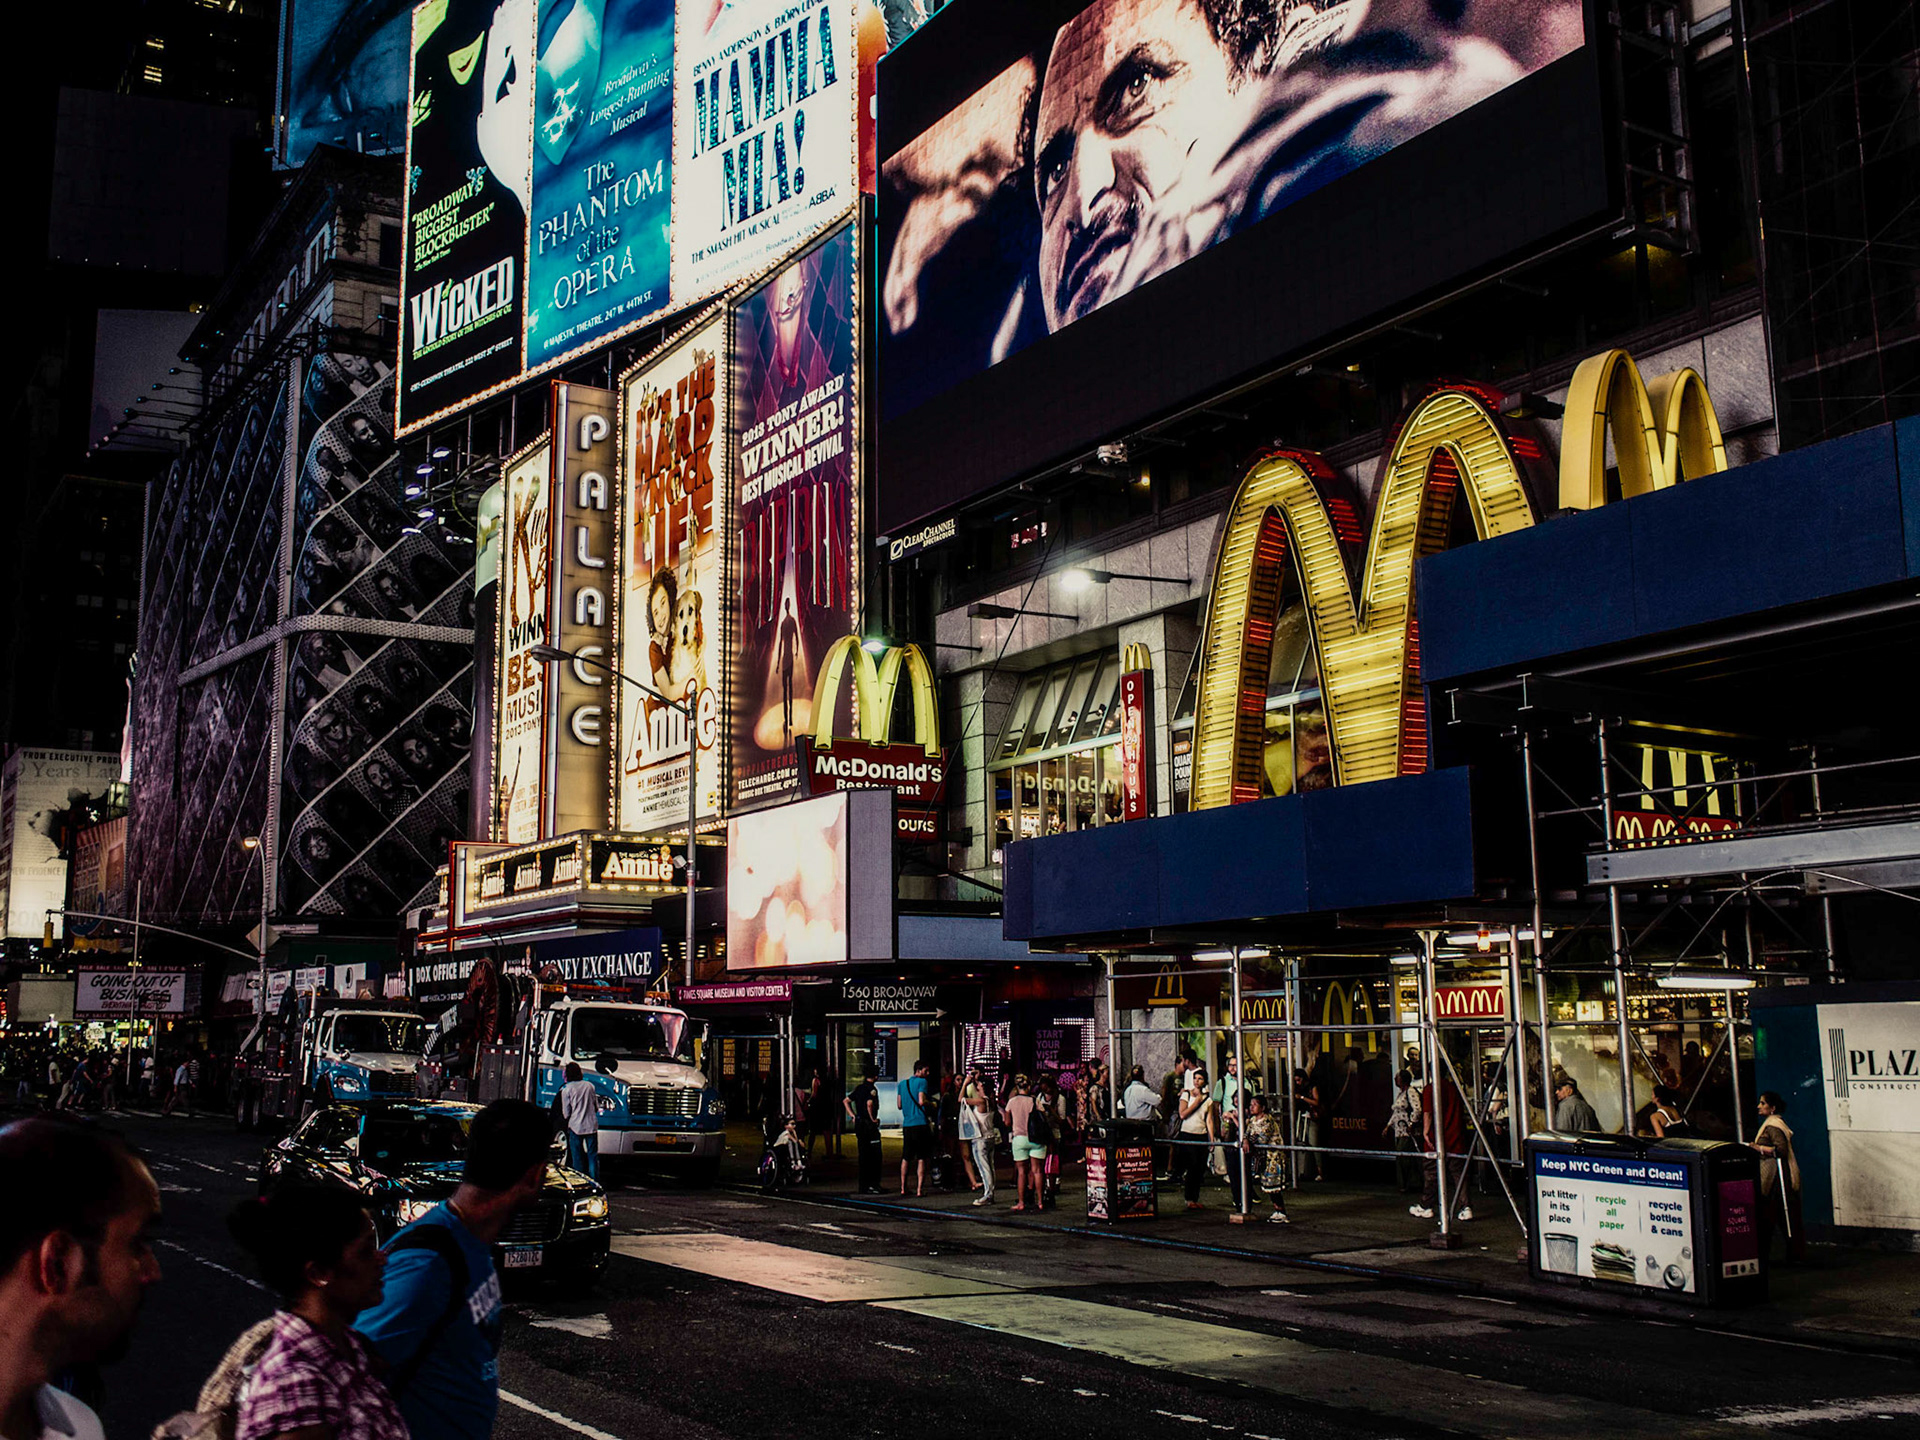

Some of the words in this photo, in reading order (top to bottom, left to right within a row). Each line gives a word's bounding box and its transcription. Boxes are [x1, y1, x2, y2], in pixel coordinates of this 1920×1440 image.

[692, 5, 838, 159] MAMMA
[609, 101, 648, 136] Musical
[583, 160, 615, 190] The
[720, 108, 806, 232] MIA!
[538, 158, 664, 257] PHANTOM
[414, 206, 460, 247] BIGGEST
[576, 231, 595, 263] of
[595, 225, 620, 255] the
[553, 245, 637, 310] OPERA
[677, 356, 716, 416] THE
[742, 421, 765, 447] 2013
[766, 400, 798, 432] TONY
[799, 376, 844, 413] AWARD
[635, 398, 715, 488] HARD
[741, 394, 845, 479] WINNER!
[741, 475, 763, 506] BEST
[763, 453, 804, 493] MUSICAL
[804, 431, 844, 471] REVIVAL
[632, 482, 715, 590] LIFE
[571, 411, 611, 746] PALACE
[23, 751, 46, 760] FROM
[49, 752, 93, 763] EXECUTIVE
[33, 761, 80, 778] Years
[815, 755, 942, 783] McDonald's
[514, 862, 542, 892] Annie
[552, 853, 582, 884] Annie
[600, 851, 674, 882] Annie
[481, 870, 505, 898] Annie
[415, 965, 432, 984] BOX
[432, 962, 458, 982] OFFICE
[540, 957, 580, 981] NEY
[582, 951, 652, 979] EXCHANGE
[91, 975, 131, 987] GOING
[133, 975, 160, 988] OUT
[160, 975, 180, 988] OF
[842, 986, 870, 998] 1560
[873, 986, 937, 998] BROADWAY
[858, 999, 919, 1011] ENTRANCE
[1036, 1029, 1064, 1039] START
[1036, 1039, 1060, 1049] YOUR
[1848, 1049, 1919, 1076] PLAZ
[1332, 1117, 1368, 1131] DELUXE
[1541, 1158, 1567, 1172] Keep
[1569, 1160, 1590, 1172] NYC
[1592, 1162, 1623, 1176] Green
[1626, 1167, 1645, 1178] and
[1648, 1168, 1683, 1181] Clean!
[1541, 1189, 1556, 1199] put
[1557, 1189, 1578, 1200] litter
[1549, 1201, 1558, 1210] in
[1559, 1202, 1570, 1211] its
[1595, 1195, 1627, 1206] recycle
[1648, 1201, 1683, 1211] recycle
[1548, 1214, 1572, 1224] place
[1599, 1221, 1625, 1230] paper
[1606, 1208, 1617, 1217] all
[1649, 1212, 1683, 1224] bottles
[1651, 1225, 1658, 1234] &
[1660, 1227, 1684, 1237] cans
